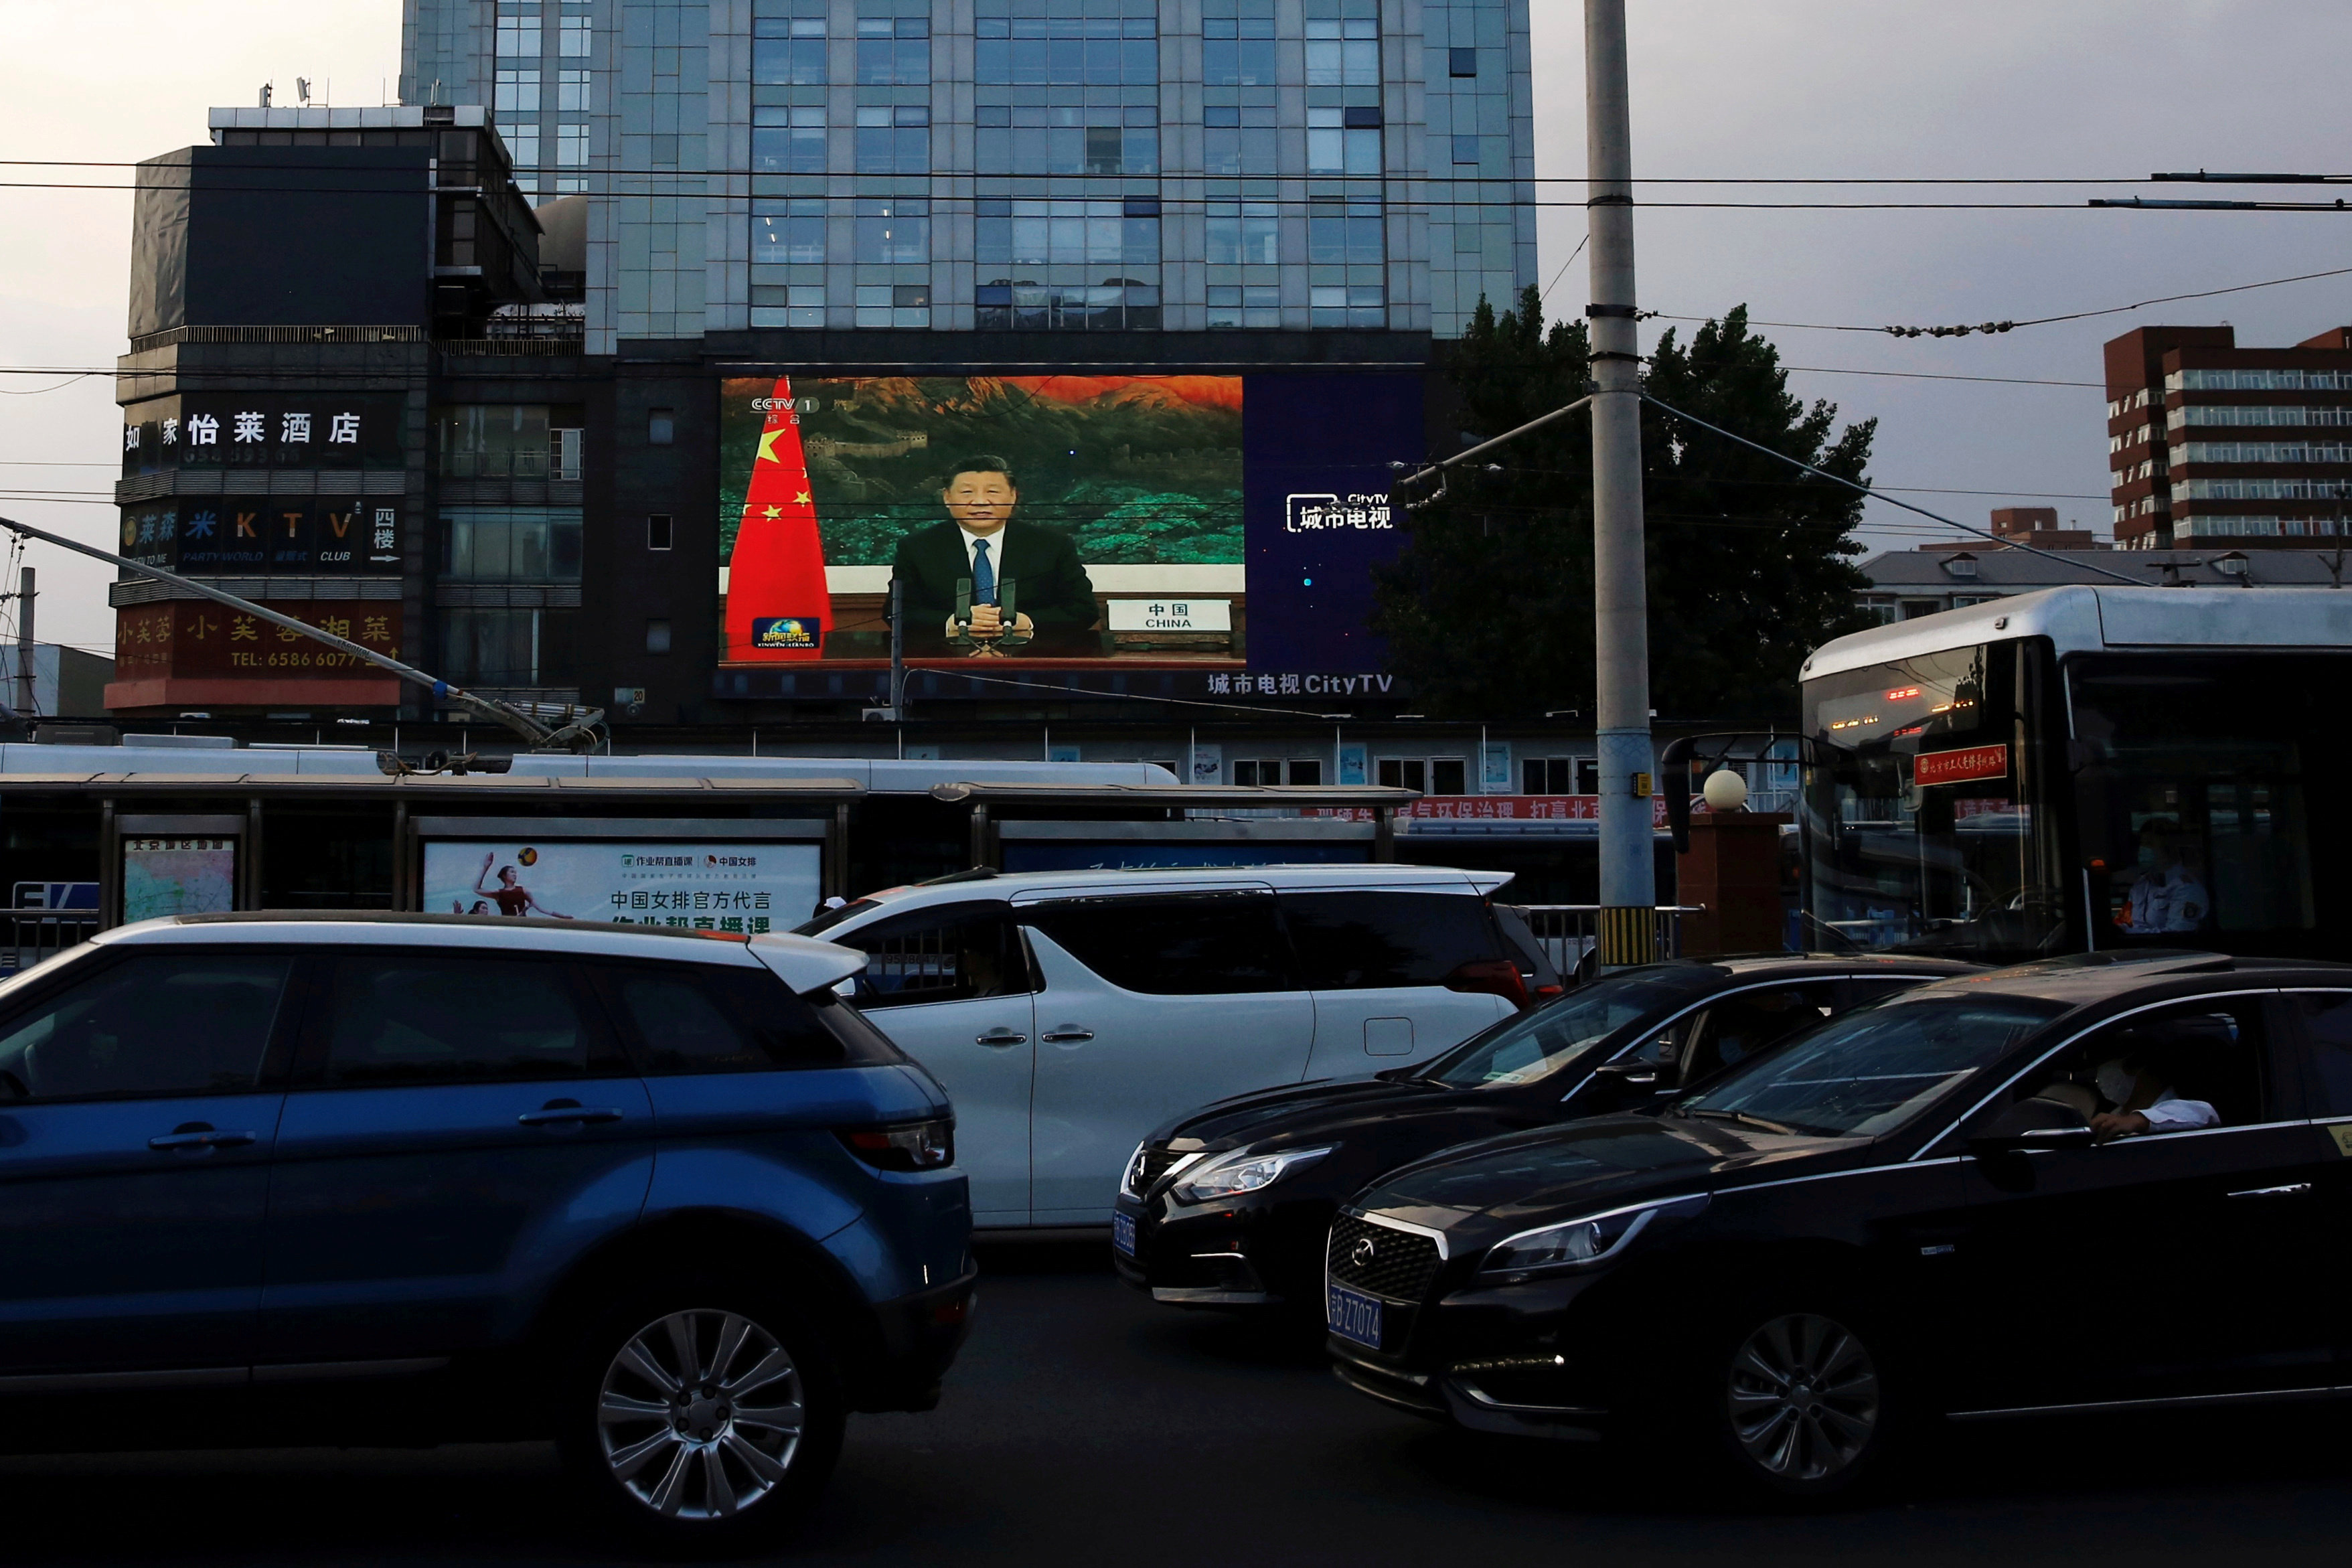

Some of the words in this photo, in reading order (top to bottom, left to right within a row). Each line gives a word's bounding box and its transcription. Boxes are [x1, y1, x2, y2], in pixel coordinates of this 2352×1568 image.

[751, 397, 796, 410] CCTV
[804, 400, 811, 411] 1
[1347, 493, 1389, 507] CityTV
[1300, 505, 1394, 530] 城市电视
[237, 512, 352, 538] KTV
[374, 508, 395, 549] 四楼
[183, 551, 221, 562] PARTY
[222, 551, 264, 562] WORLD
[320, 551, 351, 562] CLUB
[1149, 604, 1188, 616] 中国
[1146, 619, 1192, 628] CHINA
[231, 652, 262, 666] TEL:
[268, 652, 311, 666] 6586
[315, 652, 358, 666] 6077
[1207, 673, 1300, 695] 城市电视
[1305, 674, 1394, 695] CityTV
[633, 690, 643, 702] 20
[636, 856, 693, 866] 作业帮直播课
[719, 856, 757, 866] 中国女排
[611, 890, 772, 910] 中国女排官方代言
